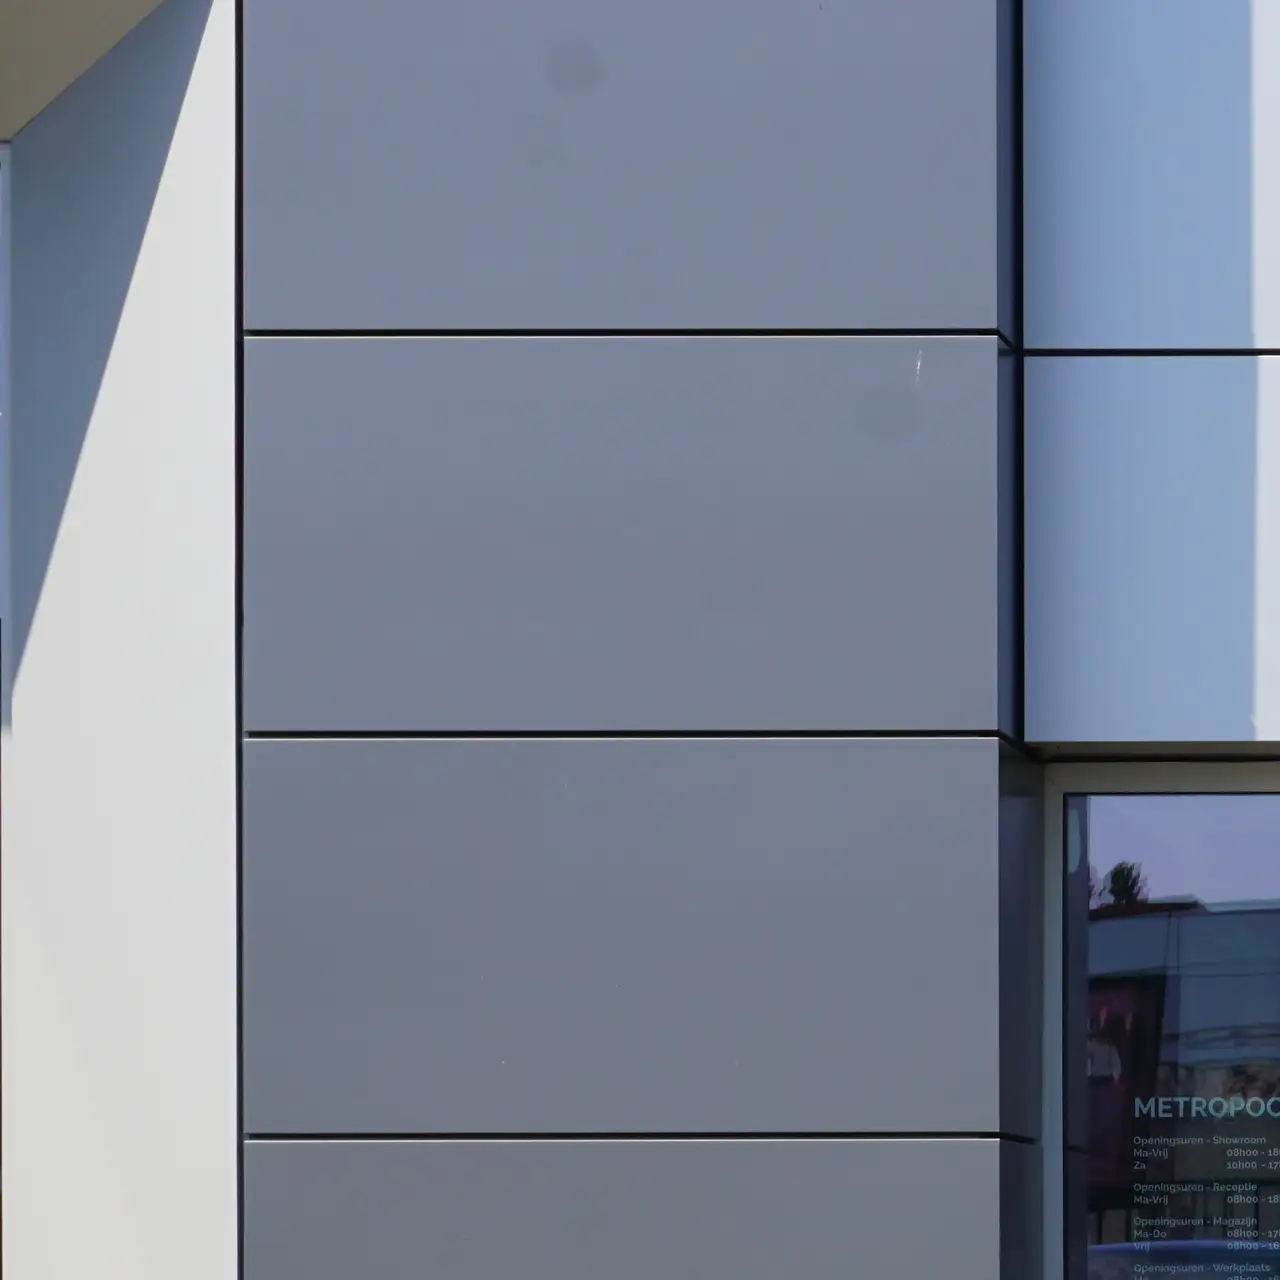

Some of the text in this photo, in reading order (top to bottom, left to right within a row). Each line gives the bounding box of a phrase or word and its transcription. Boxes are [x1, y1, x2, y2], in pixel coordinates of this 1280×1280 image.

[1133, 1136, 1204, 1147] Openingsuren
[1213, 1136, 1267, 1145] Showroom
[1133, 1148, 1168, 1159] Ma-Vrij
[1226, 1148, 1259, 1157] 08h00
[1133, 1161, 1146, 1170] Za
[1226, 1161, 1258, 1170] 10h00
[1133, 1183, 1204, 1193] Openingsuren
[1213, 1183, 1258, 1193] Receptie
[1133, 1195, 1168, 1205] Ma-Vrij
[1227, 1195, 1259, 1204] 08h00
[1133, 1217, 1204, 1227] Openingsuren
[1213, 1217, 1258, 1227] Magazijn
[1133, 1230, 1167, 1238] Ma-Do
[1227, 1230, 1259, 1238] 08h00
[1133, 1264, 1204, 1274] Openingsuren
[1213, 1264, 1271, 1274] Werkplaats
